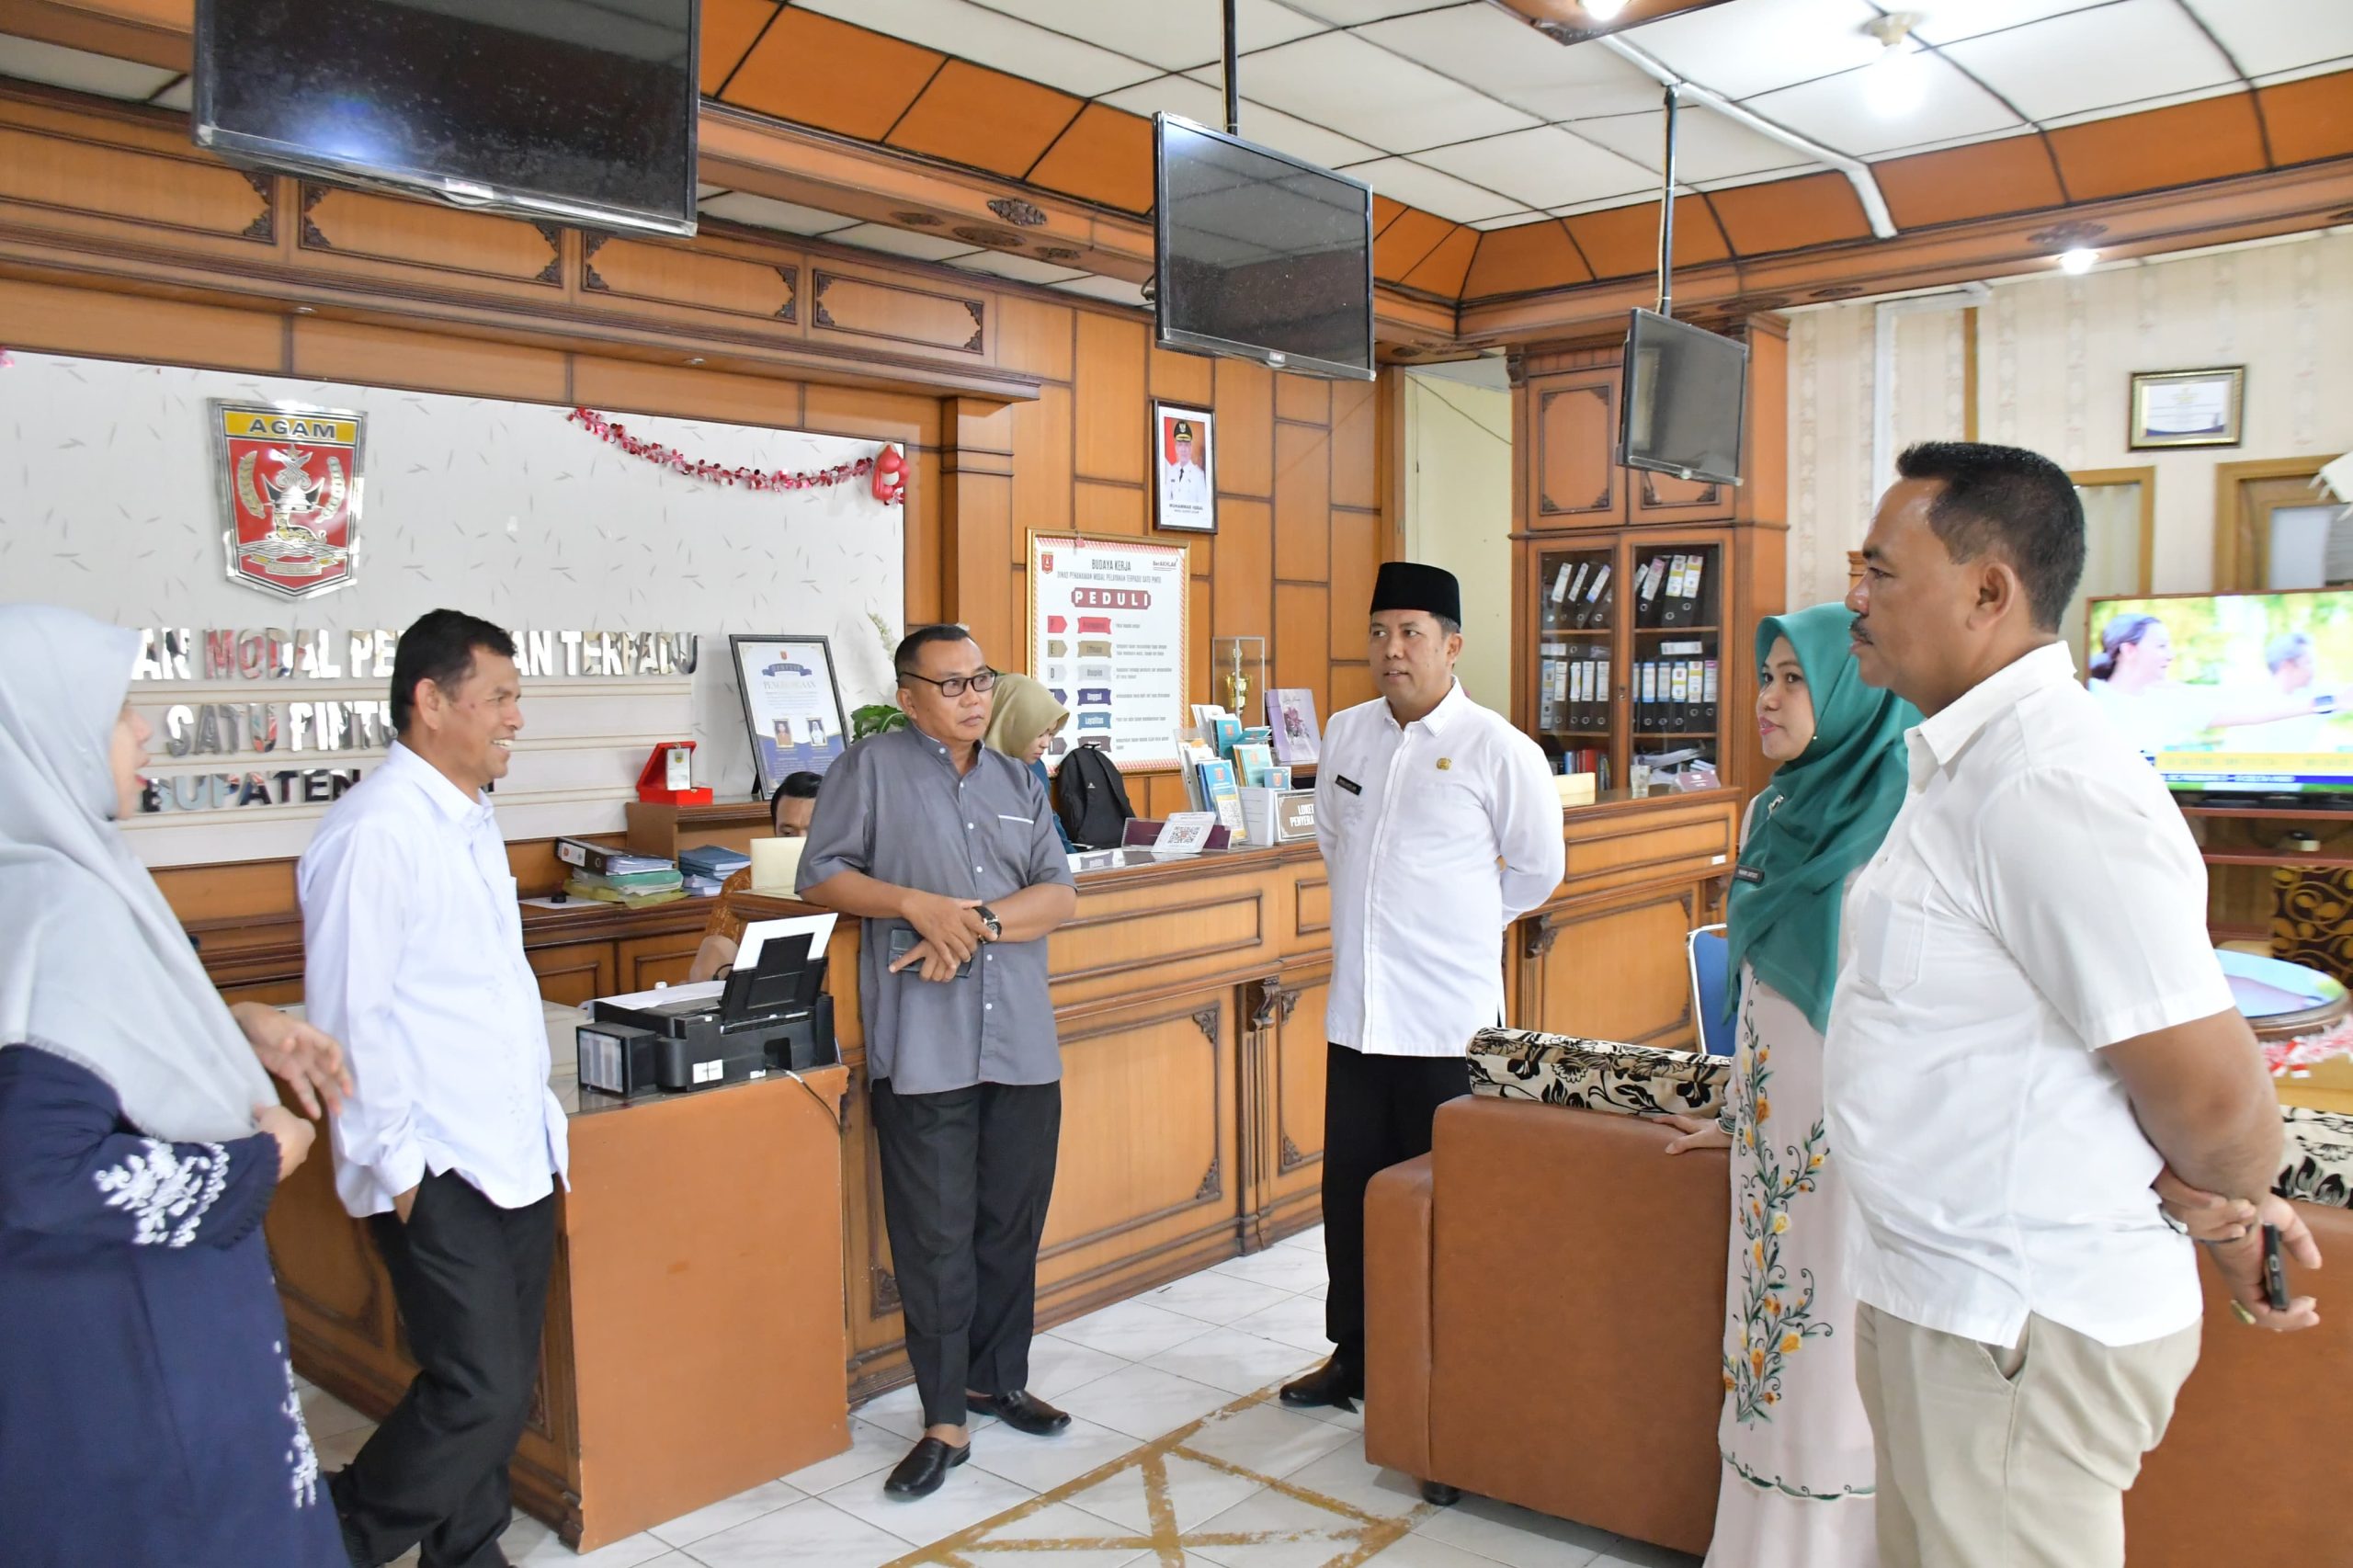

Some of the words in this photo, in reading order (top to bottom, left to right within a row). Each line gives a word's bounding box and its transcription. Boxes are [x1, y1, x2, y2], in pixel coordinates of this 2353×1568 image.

[249, 418, 335, 438] AGAM
[1092, 559, 1113, 570] BUDAYA
[1114, 561, 1131, 572] KERJA
[1074, 591, 1148, 607] PEDULI
[204, 628, 341, 680] MODAL
[559, 631, 699, 676] TERPADU
[166, 702, 278, 758] SATU
